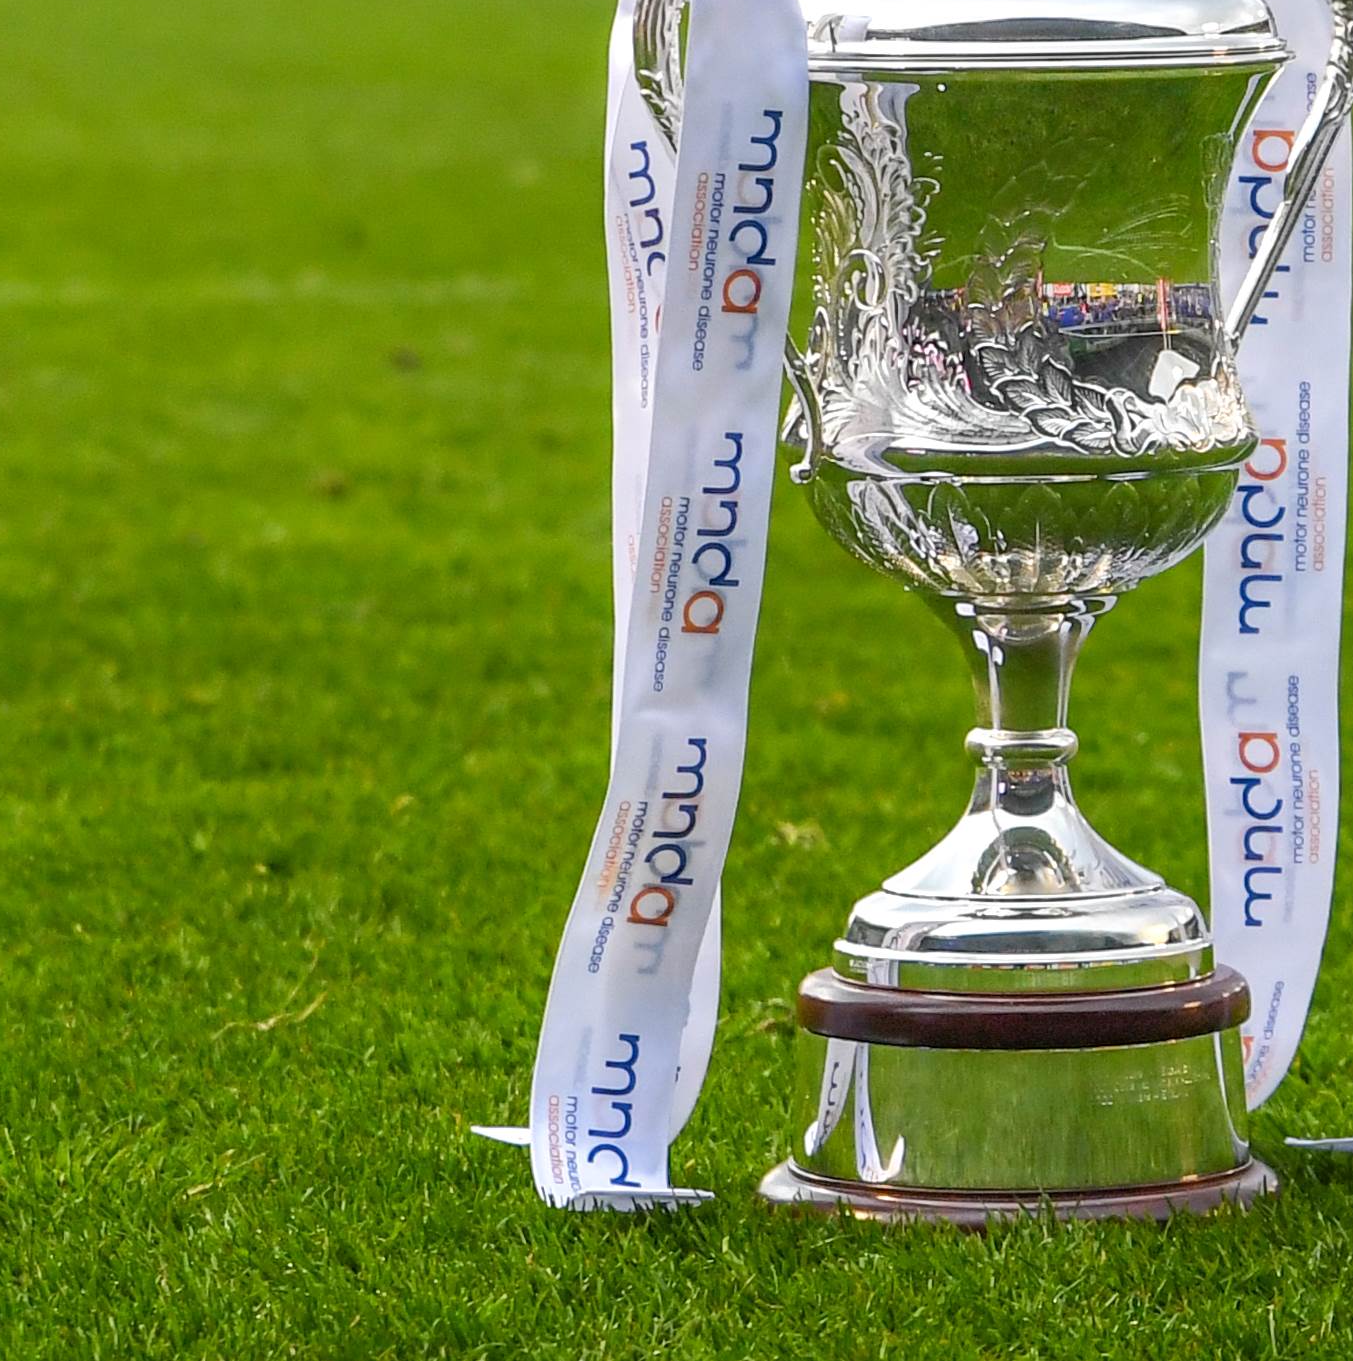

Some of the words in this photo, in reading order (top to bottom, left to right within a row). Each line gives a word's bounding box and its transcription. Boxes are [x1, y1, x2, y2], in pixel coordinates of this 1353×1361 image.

[688, 172, 709, 272] association
[709, 173, 726, 226] motor
[721, 109, 783, 314] mnda
[1321, 168, 1335, 262] association
[699, 226, 719, 301] neurone
[1303, 210, 1317, 263] motor
[635, 268, 649, 339] neurone
[692, 305, 712, 372] disease
[1299, 381, 1311, 445] disease
[1297, 449, 1309, 525] neurone
[650, 496, 673, 593] association
[675, 496, 690, 550] motor
[681, 432, 743, 634] mnda
[1237, 439, 1287, 634] mnda
[1296, 524, 1308, 573] motor
[1314, 476, 1325, 571] association
[661, 552, 682, 622] neurone
[653, 627, 670, 692] disease
[1286, 675, 1299, 738] disease
[1292, 742, 1304, 811] neurone
[596, 801, 631, 889] association
[626, 738, 707, 927] mnda
[631, 801, 648, 852] motor
[1230, 732, 1283, 927] mnda
[1293, 814, 1304, 864] motor
[1310, 769, 1319, 863] association
[606, 852, 634, 914] neurone
[588, 916, 615, 974] disease
[549, 1095, 564, 1185] association
[565, 1096, 578, 1147] motor
